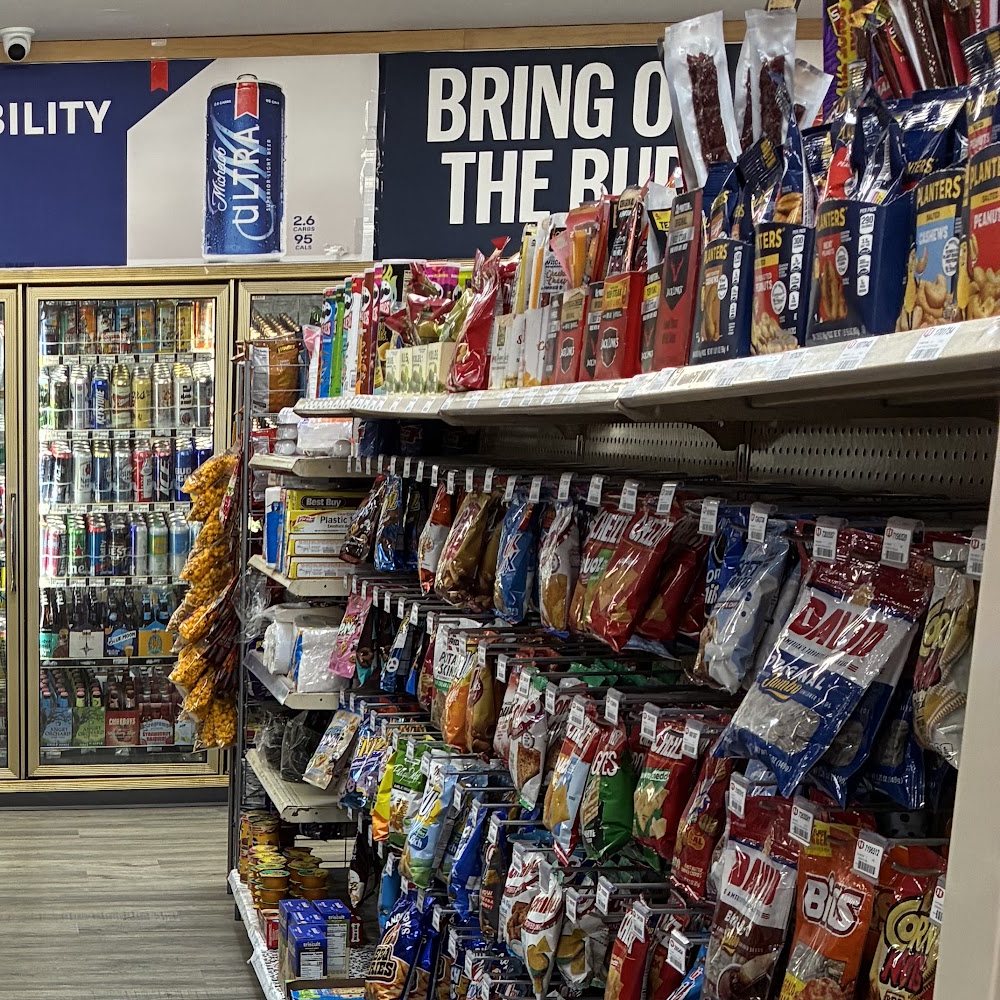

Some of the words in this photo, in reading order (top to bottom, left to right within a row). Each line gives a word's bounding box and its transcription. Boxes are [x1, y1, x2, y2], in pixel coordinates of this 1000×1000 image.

[427, 62, 614, 142] BRING
[211, 147, 227, 212] Michelob
[232, 124, 259, 224] ULTRA
[441, 149, 553, 224] THE
[917, 175, 961, 207] PLANTERS
[293, 215, 315, 226] 2.6
[919, 226, 949, 245] CASHEWS
[294, 234, 313, 244] 95
[306, 498, 325, 506] Best
[326, 498, 342, 507] Buy
[320, 515, 347, 524] Plastic
[788, 596, 889, 657] DAVID
